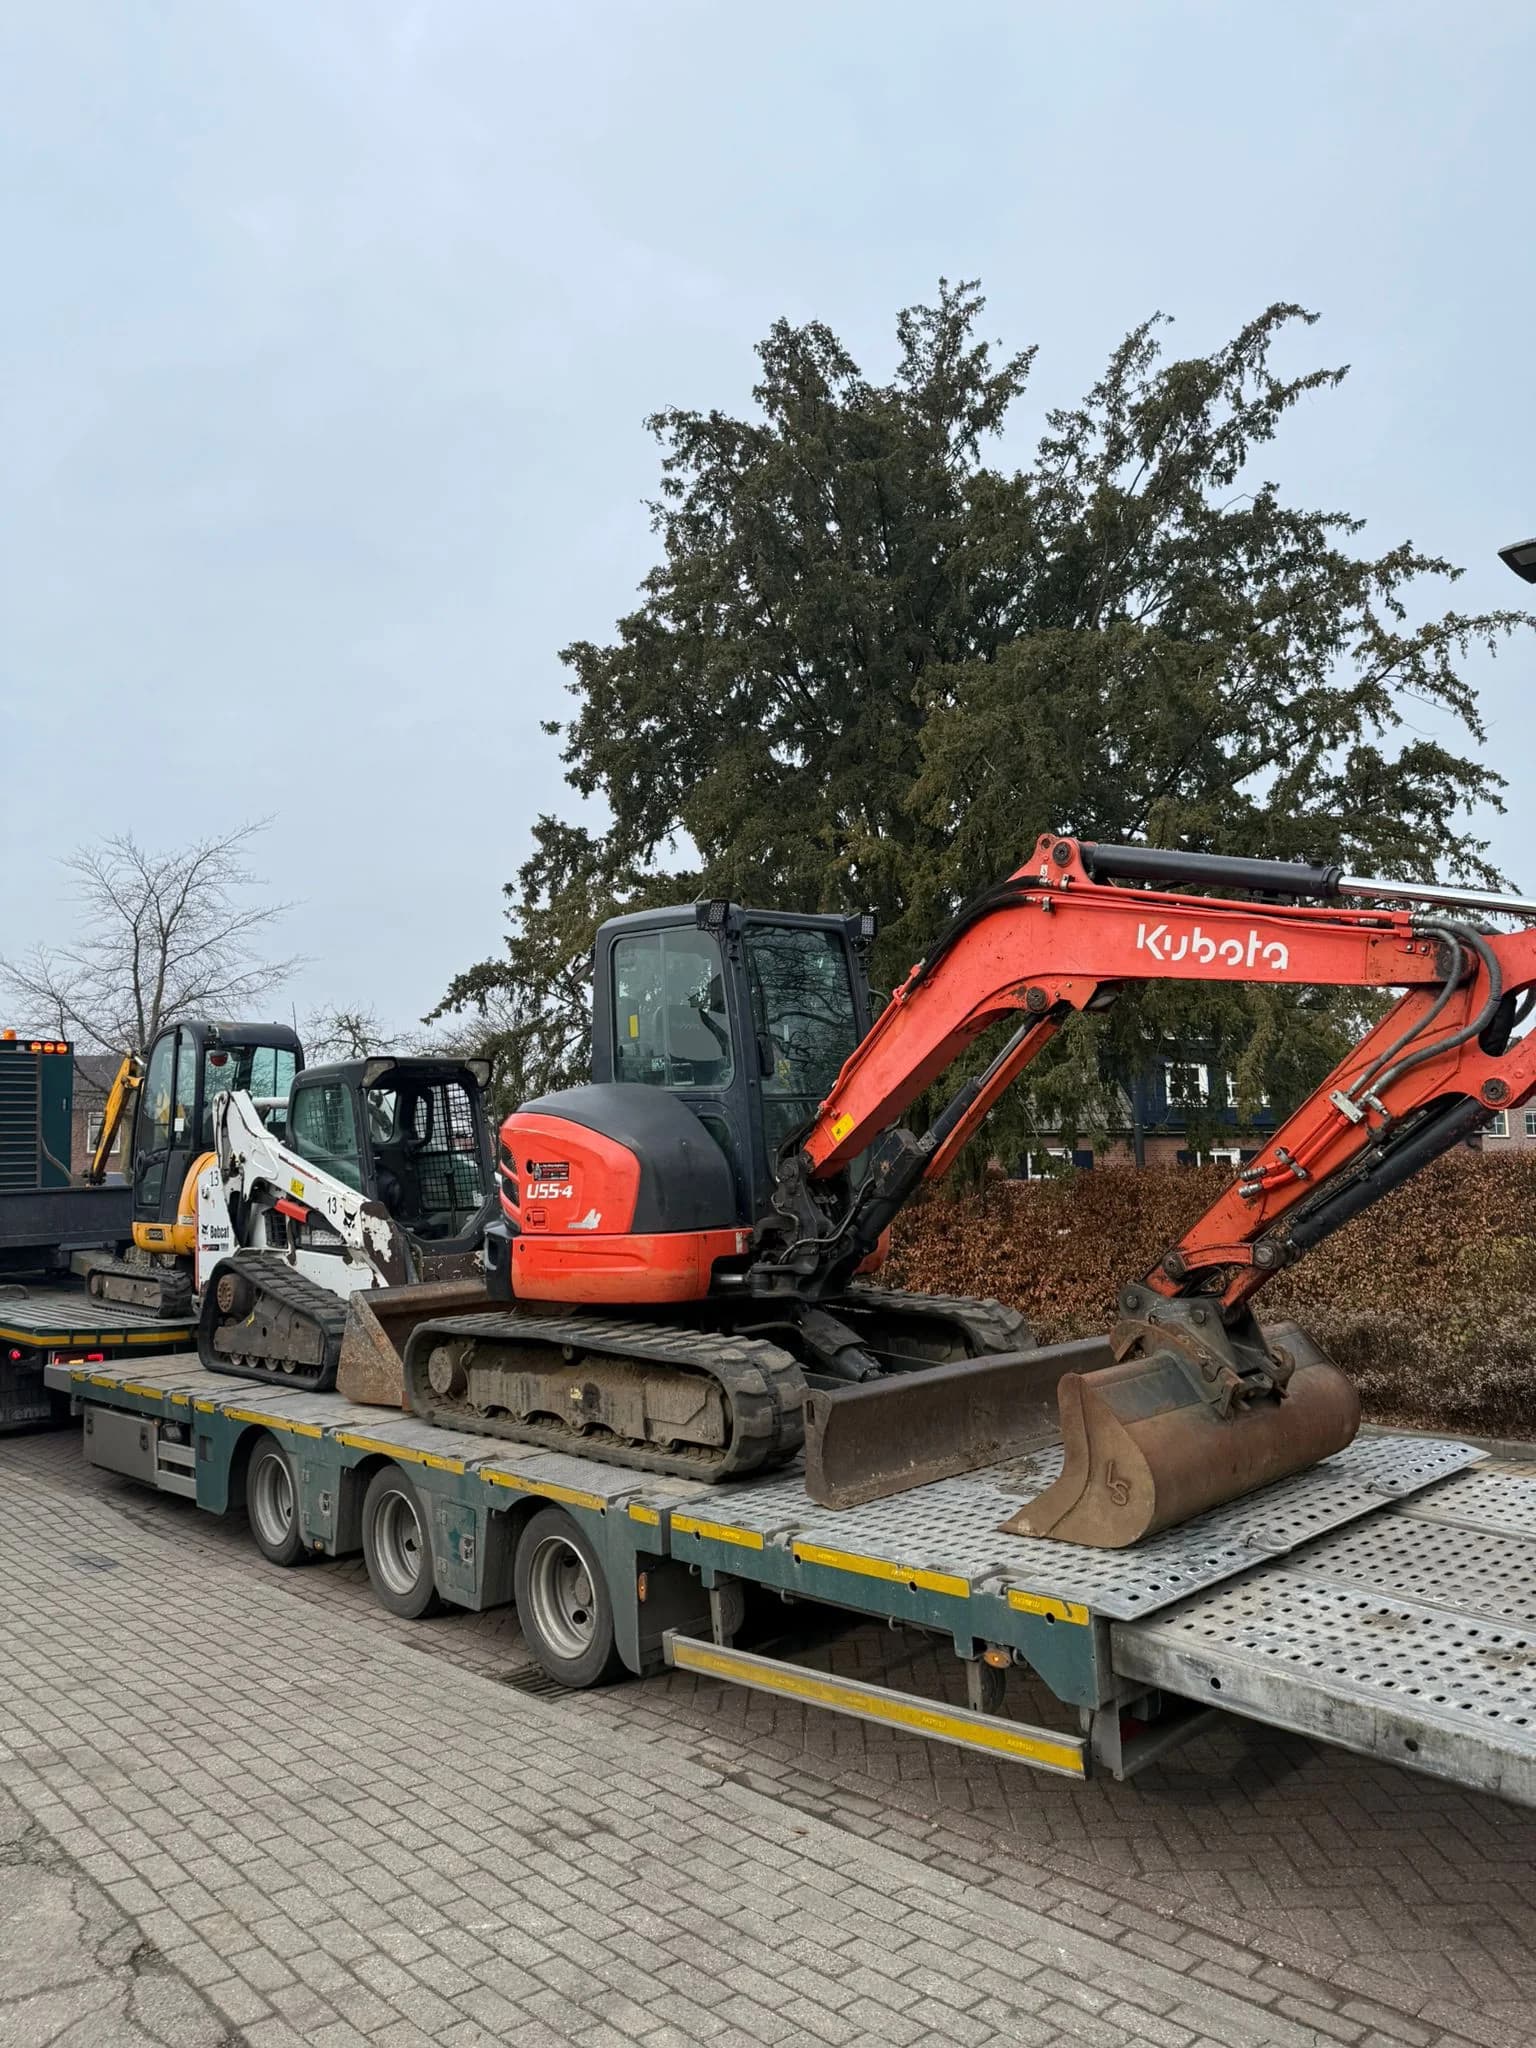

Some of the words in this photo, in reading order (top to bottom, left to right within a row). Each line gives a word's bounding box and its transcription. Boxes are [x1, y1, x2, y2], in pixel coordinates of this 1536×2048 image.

[1136, 923, 1289, 970] Kubota
[209, 1170, 219, 1187] 13
[327, 1196, 337, 1214] 13
[210, 1225, 230, 1239] Bobcat
